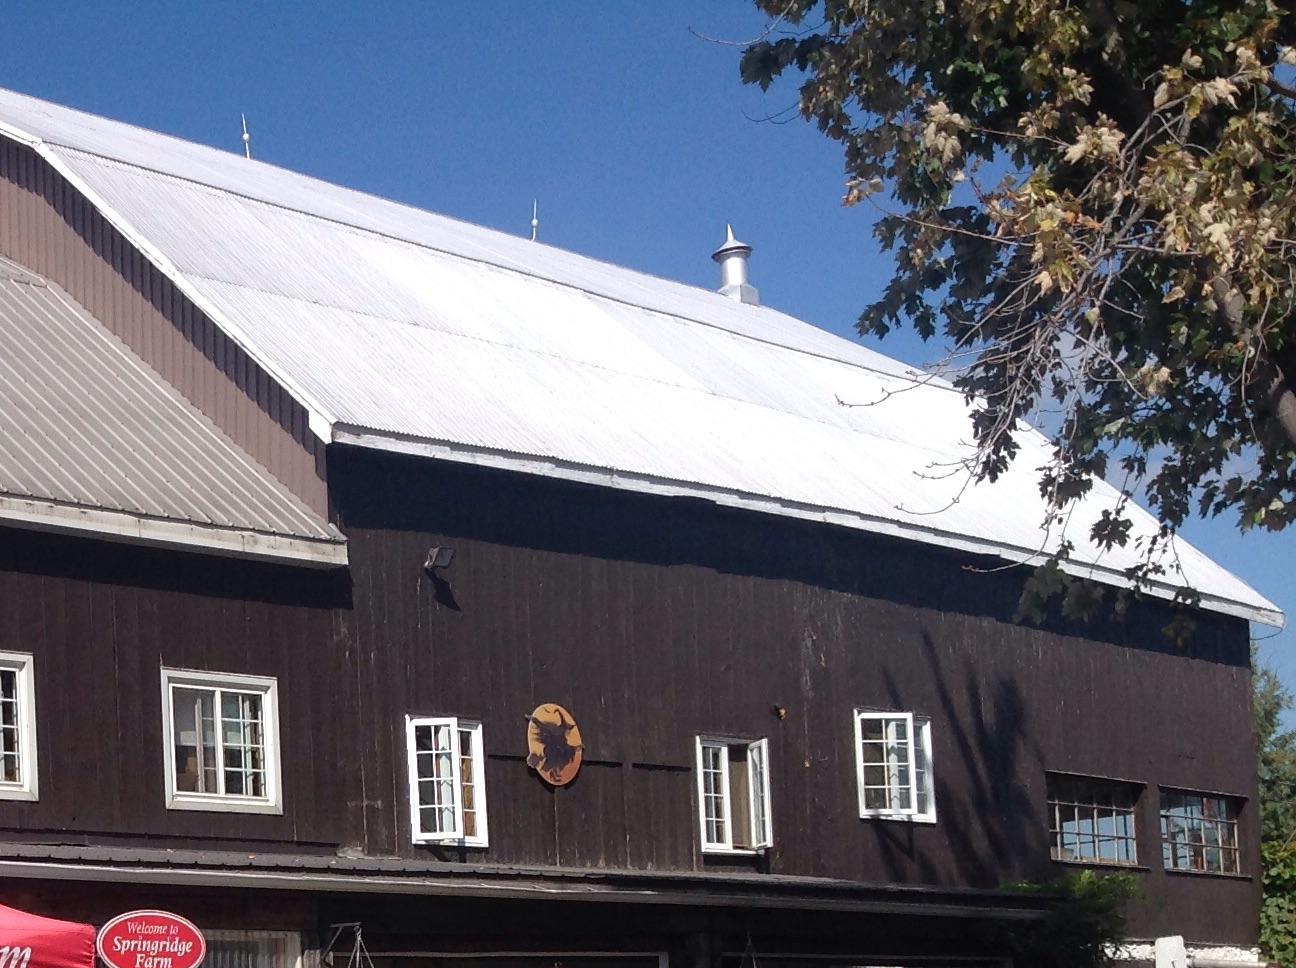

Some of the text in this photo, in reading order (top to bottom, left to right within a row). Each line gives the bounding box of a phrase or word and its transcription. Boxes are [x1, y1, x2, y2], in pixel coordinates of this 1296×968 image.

[127, 921, 179, 934] Welcome to
[113, 936, 192, 956] Springridge
[135, 954, 172, 968] Farm
